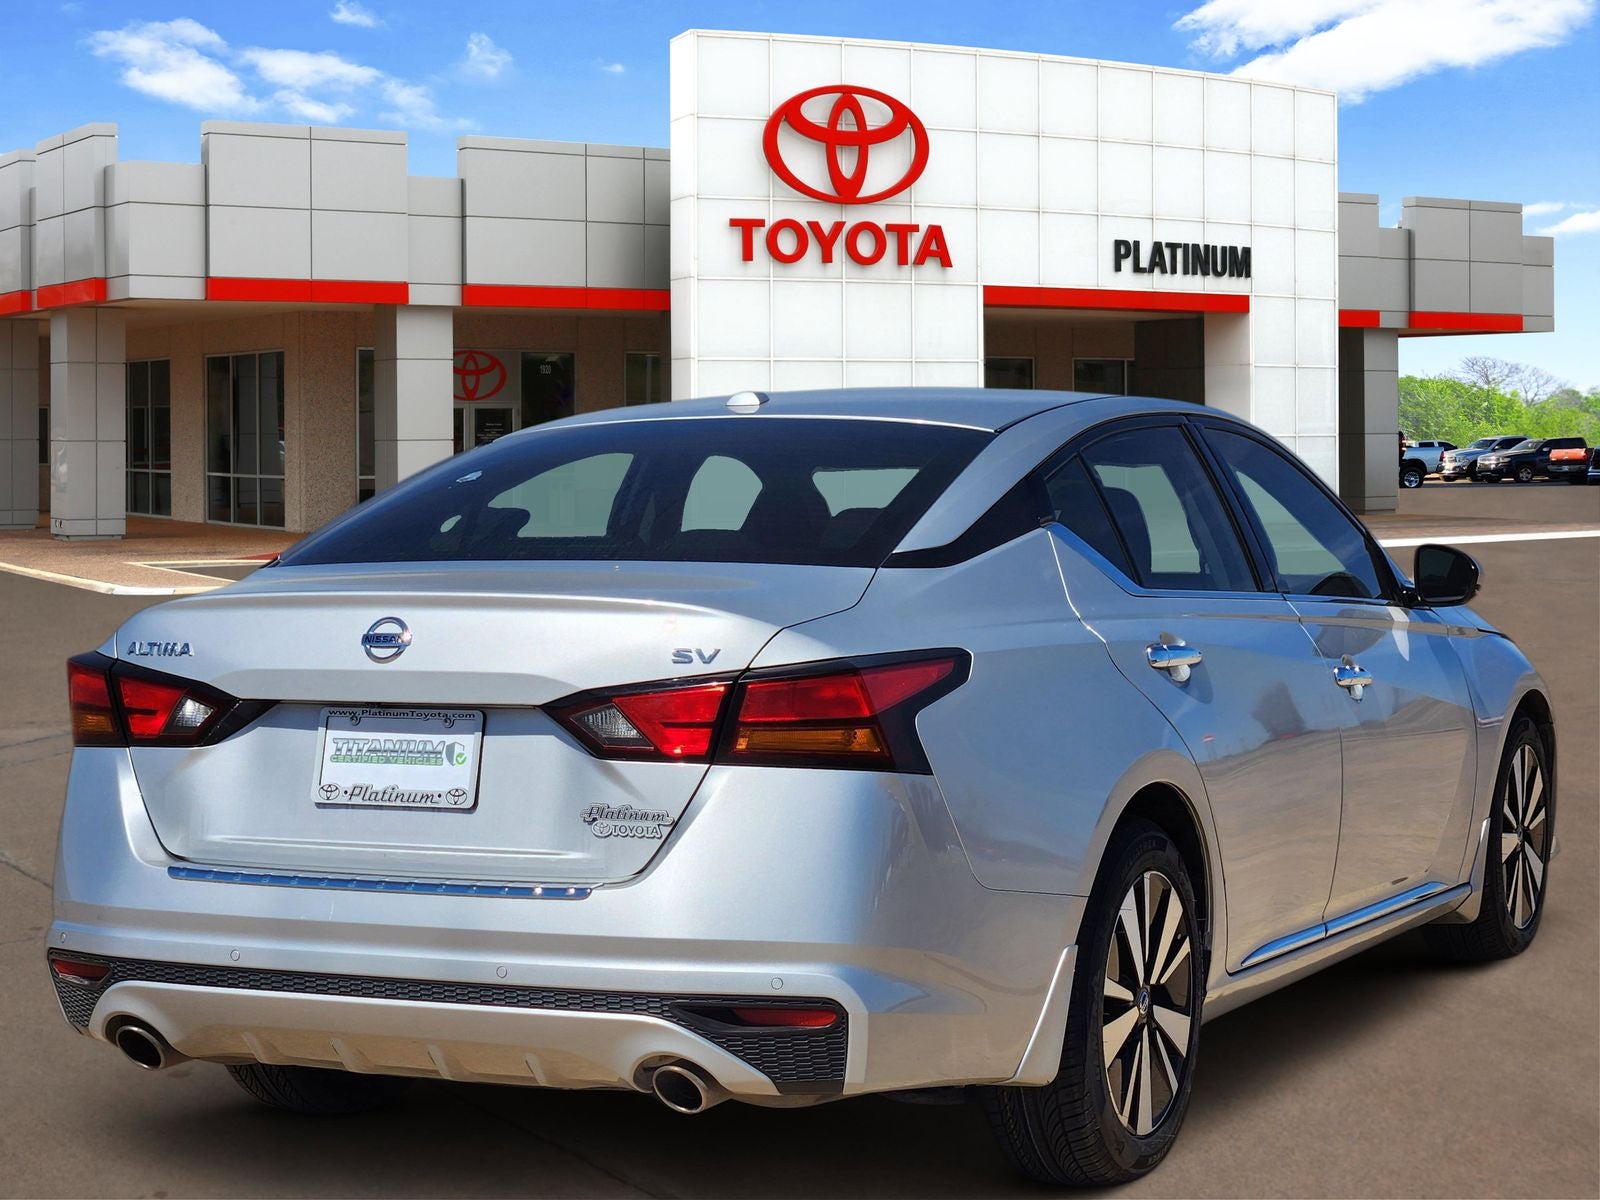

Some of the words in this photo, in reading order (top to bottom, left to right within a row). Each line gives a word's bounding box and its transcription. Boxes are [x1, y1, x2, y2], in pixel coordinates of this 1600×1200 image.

[729, 218, 953, 268] TOYOTA
[1114, 239, 1252, 278] PLATINUM
[127, 641, 194, 657] ALTIMA
[672, 648, 721, 664] SV
[328, 709, 476, 721] www.PlatinumToyota.com
[333, 738, 446, 756] TITANIUM
[330, 754, 386, 764] CERTIFIED
[389, 755, 444, 766] VEHICLES
[349, 784, 440, 804] Platinum
[582, 804, 671, 823] Platinum
[612, 824, 660, 837] TOYOTA
